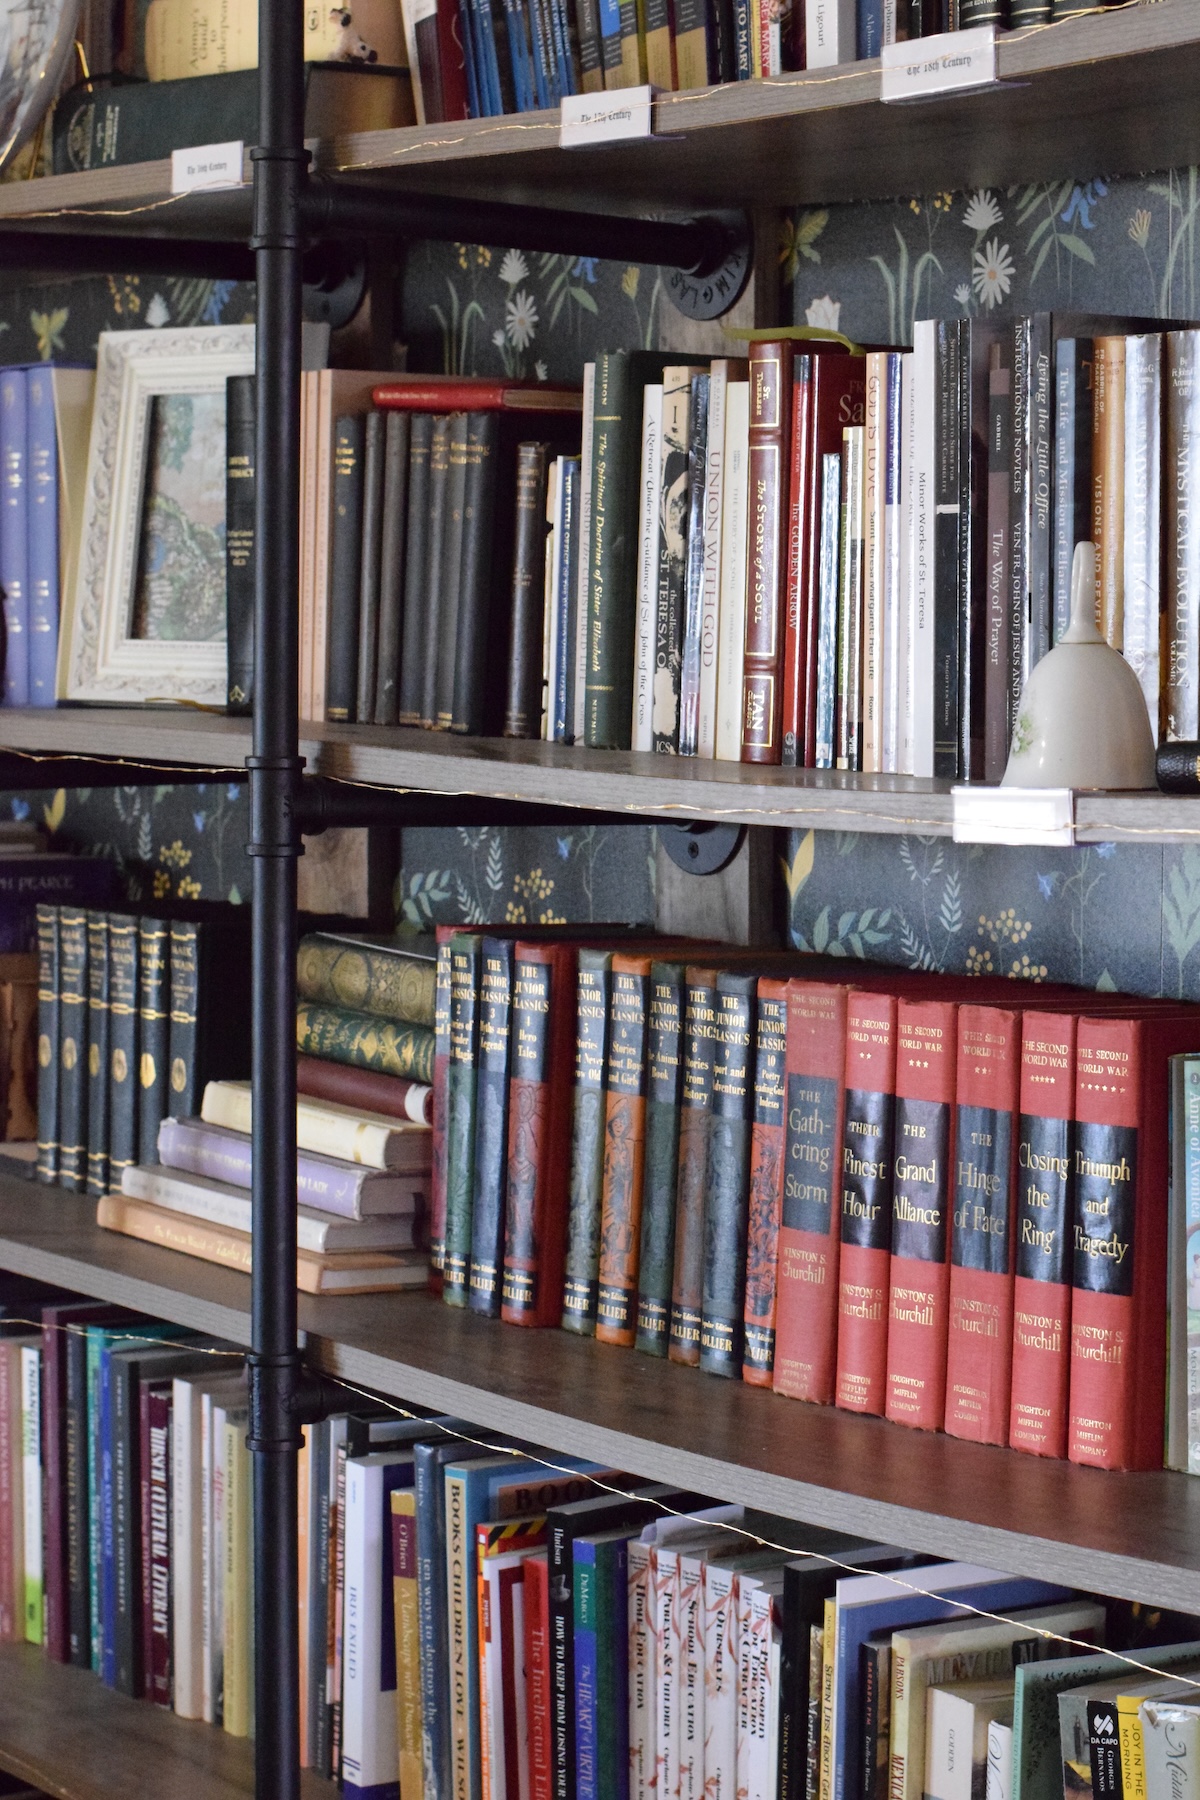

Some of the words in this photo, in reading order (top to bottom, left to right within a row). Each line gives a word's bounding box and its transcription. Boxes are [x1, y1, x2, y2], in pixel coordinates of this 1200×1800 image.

[739, 3, 749, 26] TO
[817, 4, 828, 48] Ligouri
[738, 29, 750, 71] MARY
[760, 29, 771, 69] MARY
[942, 55, 972, 70] Century
[763, 386, 771, 400] ST.
[1035, 352, 1048, 404] Living
[1059, 368, 1069, 397] The
[1014, 416, 1022, 435] OF
[1038, 408, 1048, 432] the
[1059, 401, 1068, 429] Life
[599, 433, 607, 456] The
[1037, 437, 1048, 477] Little
[1059, 437, 1068, 464] and
[1013, 438, 1022, 494] NOVICES
[596, 460, 606, 511] Spiritual
[707, 451, 720, 532] UNION
[757, 480, 767, 500] The
[918, 472, 926, 510] Minor
[1058, 469, 1068, 527] Mission
[791, 502, 800, 521] The
[1034, 482, 1048, 530] Office
[595, 515, 605, 566] Doctrine
[757, 504, 767, 554] STORY
[918, 513, 926, 551] Works
[992, 528, 1004, 556] The
[1013, 522, 1022, 552] VEN.
[1058, 530, 1068, 546] of
[659, 550, 670, 573] ST.
[754, 557, 764, 570] of
[790, 526, 800, 577] GOLDEN
[919, 555, 926, 568] of
[1013, 553, 1022, 573] FR.
[593, 569, 603, 583] of
[704, 540, 717, 606] WITH
[989, 561, 1003, 594] Way
[1058, 550, 1068, 586] Elias
[593, 585, 603, 615] Sister
[669, 590, 677, 605] the
[754, 583, 765, 624] SOUL
[789, 582, 798, 629] ARROW
[991, 595, 1003, 613] of
[1012, 575, 1021, 611] JOHN
[1058, 588, 1067, 607] the
[657, 577, 669, 648] TERESA
[1012, 613, 1020, 630] OF
[668, 607, 677, 650] collected
[703, 614, 715, 668] GOD
[989, 617, 1003, 665] Prayer
[591, 620, 601, 672] Elizabeth
[1012, 632, 1020, 666] JESUS
[1012, 668, 1020, 698] AND
[752, 690, 765, 730] TAN
[487, 959, 501, 971] THE
[521, 966, 538, 978] THE
[578, 972, 595, 985] THE
[515, 982, 544, 996] JUNIOR
[618, 977, 634, 990] THE
[689, 990, 706, 1003] THE
[722, 996, 739, 1009] THE
[764, 1003, 779, 1016] THE
[716, 1012, 745, 1028] JUNIOR
[758, 1019, 785, 1034] JUNIOR
[861, 1018, 890, 1031] SECOND
[519, 1030, 537, 1042] Hero
[612, 1042, 636, 1056] Stories
[871, 1033, 890, 1046] WAR
[518, 1045, 537, 1058] Tales
[767, 1055, 776, 1066] 10
[848, 1120, 881, 1138] THEIR
[903, 1124, 927, 1139] THE
[971, 1132, 993, 1147] THE
[792, 1139, 830, 1172] ering
[843, 1147, 886, 1180] Finest
[895, 1155, 937, 1184] Grand
[1018, 1142, 1071, 1181] Closing
[1074, 1149, 1132, 1186] Triumph
[785, 1172, 828, 1204] Storm
[957, 1161, 1001, 1197] Hinge
[843, 1190, 881, 1221] Hour
[893, 1194, 941, 1226] Alliance
[1026, 1184, 1050, 1208] the
[1086, 1196, 1110, 1216] and
[954, 1200, 972, 1229] of
[972, 1204, 1005, 1236] Fate
[1020, 1218, 1056, 1254] Ring
[1072, 1224, 1129, 1264] Tragedy
[782, 1259, 826, 1285] Churchill
[417, 1467, 425, 1507] ESOLEN
[452, 1484, 462, 1554] BOOKS
[399, 1523, 408, 1570] O'Brien
[554, 1527, 564, 1565] Hudson
[424, 1558, 432, 1581] ten
[424, 1586, 433, 1621] ways
[453, 1559, 466, 1665] CHILDREN
[425, 1625, 435, 1640] to
[531, 1628, 545, 1659] The
[555, 1616, 565, 1642] HOW
[555, 1643, 565, 1660] TO
[715, 1611, 726, 1693] OURSELVES
[425, 1644, 436, 1697] destroy
[555, 1662, 566, 1691] KEEP
[894, 1655, 906, 1701] PARSONS
[454, 1670, 464, 1722] LOVE
[556, 1693, 566, 1725] FROM
[428, 1702, 437, 1724] the
[532, 1663, 547, 1770] Intellectual
[808, 1698, 818, 1752] Merrie
[556, 1726, 566, 1765] LOSING
[1132, 1724, 1141, 1751] JOY
[1097, 1748, 1105, 1792] BERNANOS
[1122, 1728, 1132, 1790] MORNING
[1134, 1754, 1142, 1766] IN
[557, 1768, 567, 1797] YOUR
[1135, 1771, 1143, 1796] THE
